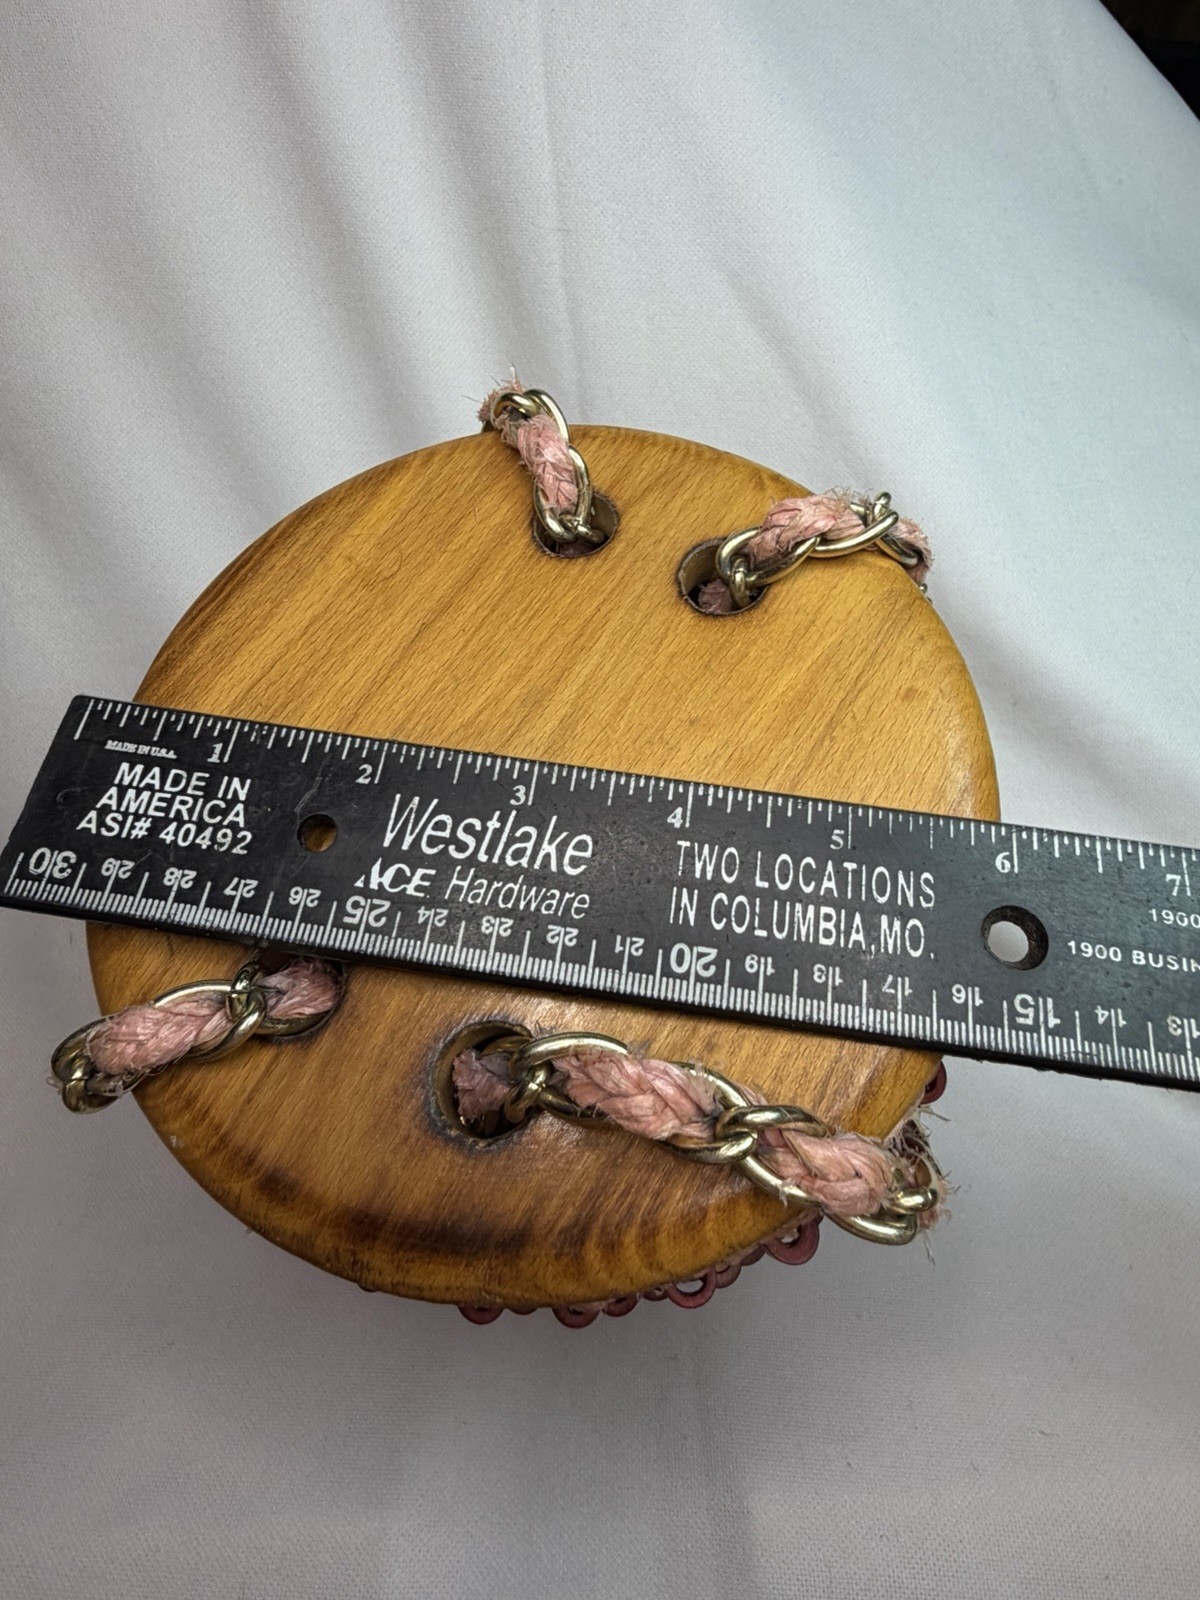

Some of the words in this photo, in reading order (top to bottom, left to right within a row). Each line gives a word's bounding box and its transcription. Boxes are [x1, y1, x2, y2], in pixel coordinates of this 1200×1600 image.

[207, 743, 223, 763] 1
[113, 762, 210, 796] MADE
[217, 775, 251, 801] IN
[355, 764, 372, 784] 2
[95, 786, 246, 828] AMERICA
[510, 785, 526, 806] 3
[667, 807, 683, 828] 4
[76, 810, 152, 839] ASI#
[158, 821, 253, 855] 40492
[382, 793, 594, 876] Westlake
[830, 829, 844, 850] 5
[28, 847, 77, 880] 30
[101, 857, 135, 880] 29
[995, 852, 1011, 873] 6
[162, 867, 197, 889] 28
[676, 840, 740, 884] TWO
[754, 850, 936, 909] LOCATIONS
[1165, 874, 1181, 897] 7
[223, 877, 258, 898] 27
[288, 886, 322, 908] 26
[444, 864, 591, 919] Hardware
[342, 895, 391, 928] 25
[417, 906, 449, 927] 24
[668, 886, 699, 926] IN
[481, 915, 514, 937] 23
[546, 924, 579, 947] 22
[614, 934, 646, 957] 21
[1066, 940, 1123, 963] 1900
[669, 942, 718, 978] 20
[744, 953, 776, 977] 19
[881, 974, 913, 997] 17
[951, 983, 984, 1007] 16
[1013, 993, 1061, 1028] 15
[1094, 1005, 1127, 1028] 14
